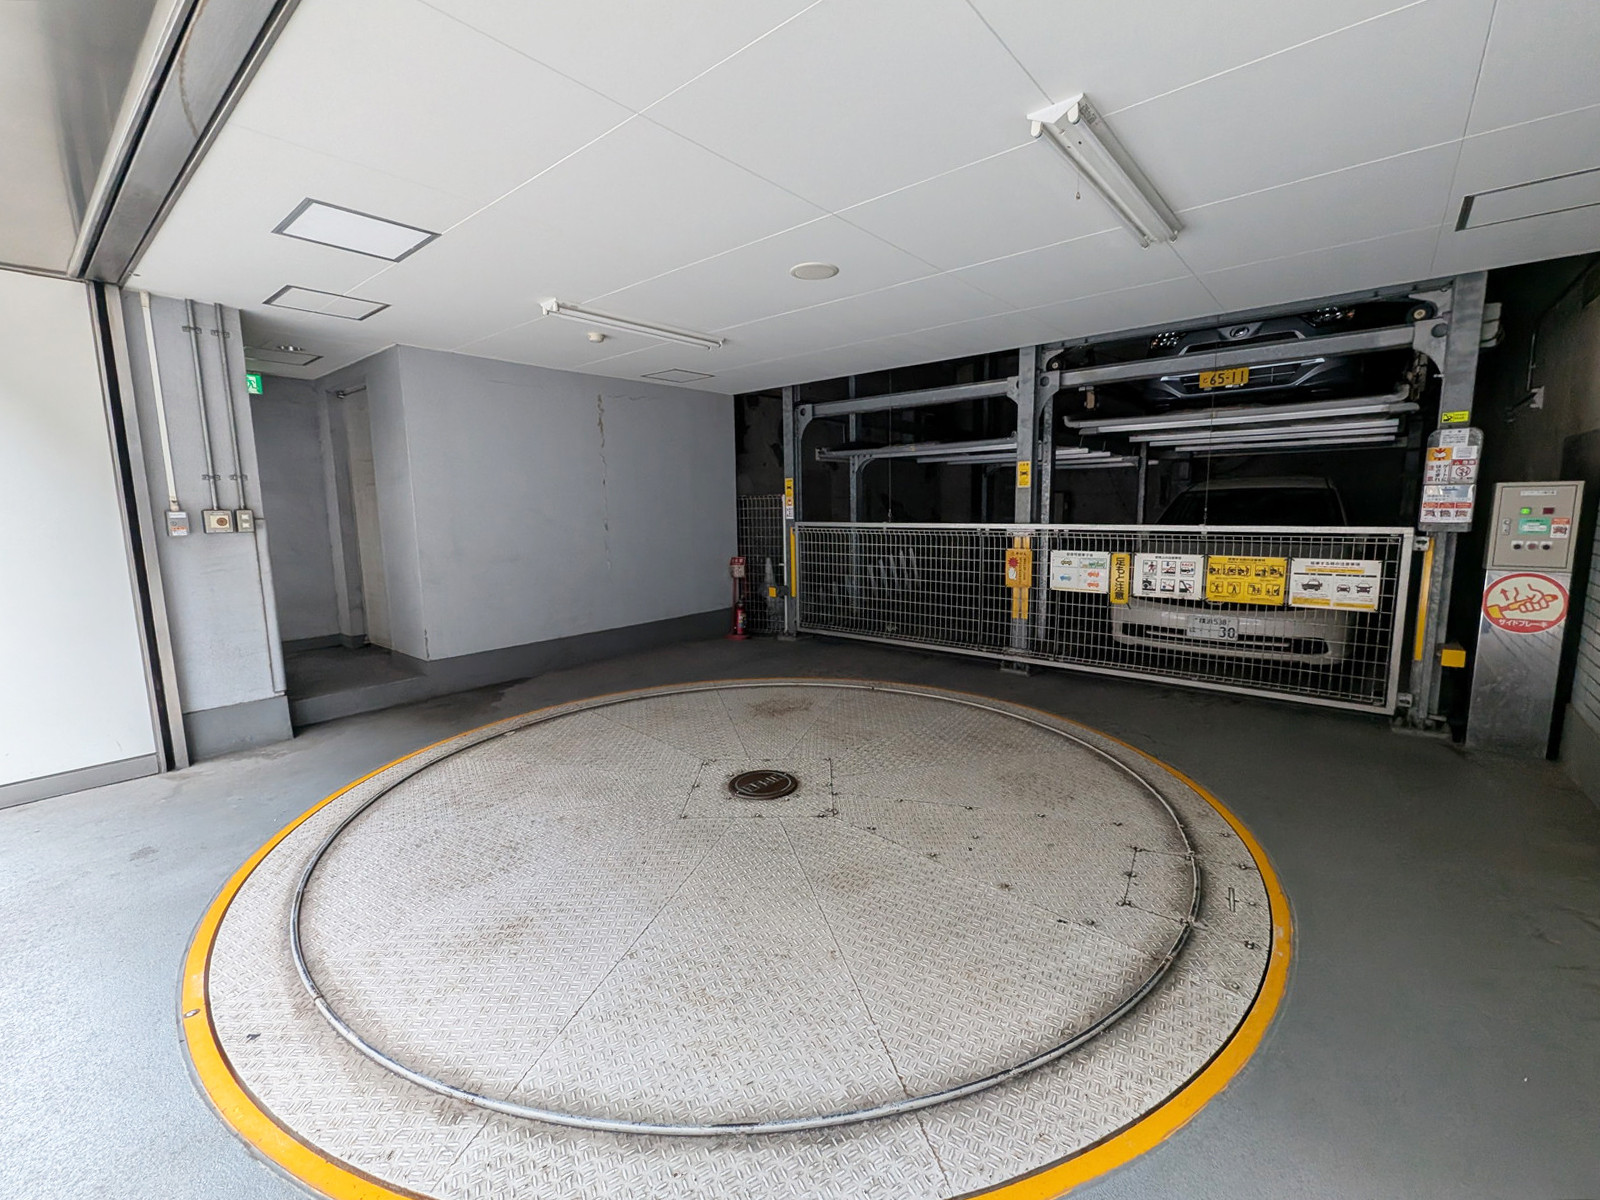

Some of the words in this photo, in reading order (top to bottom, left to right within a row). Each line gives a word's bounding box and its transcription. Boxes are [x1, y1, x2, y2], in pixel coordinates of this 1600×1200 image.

[1209, 371, 1244, 385] 65-11
[1114, 556, 1126, 601] 足もと注意
[1219, 626, 1236, 639] 30
